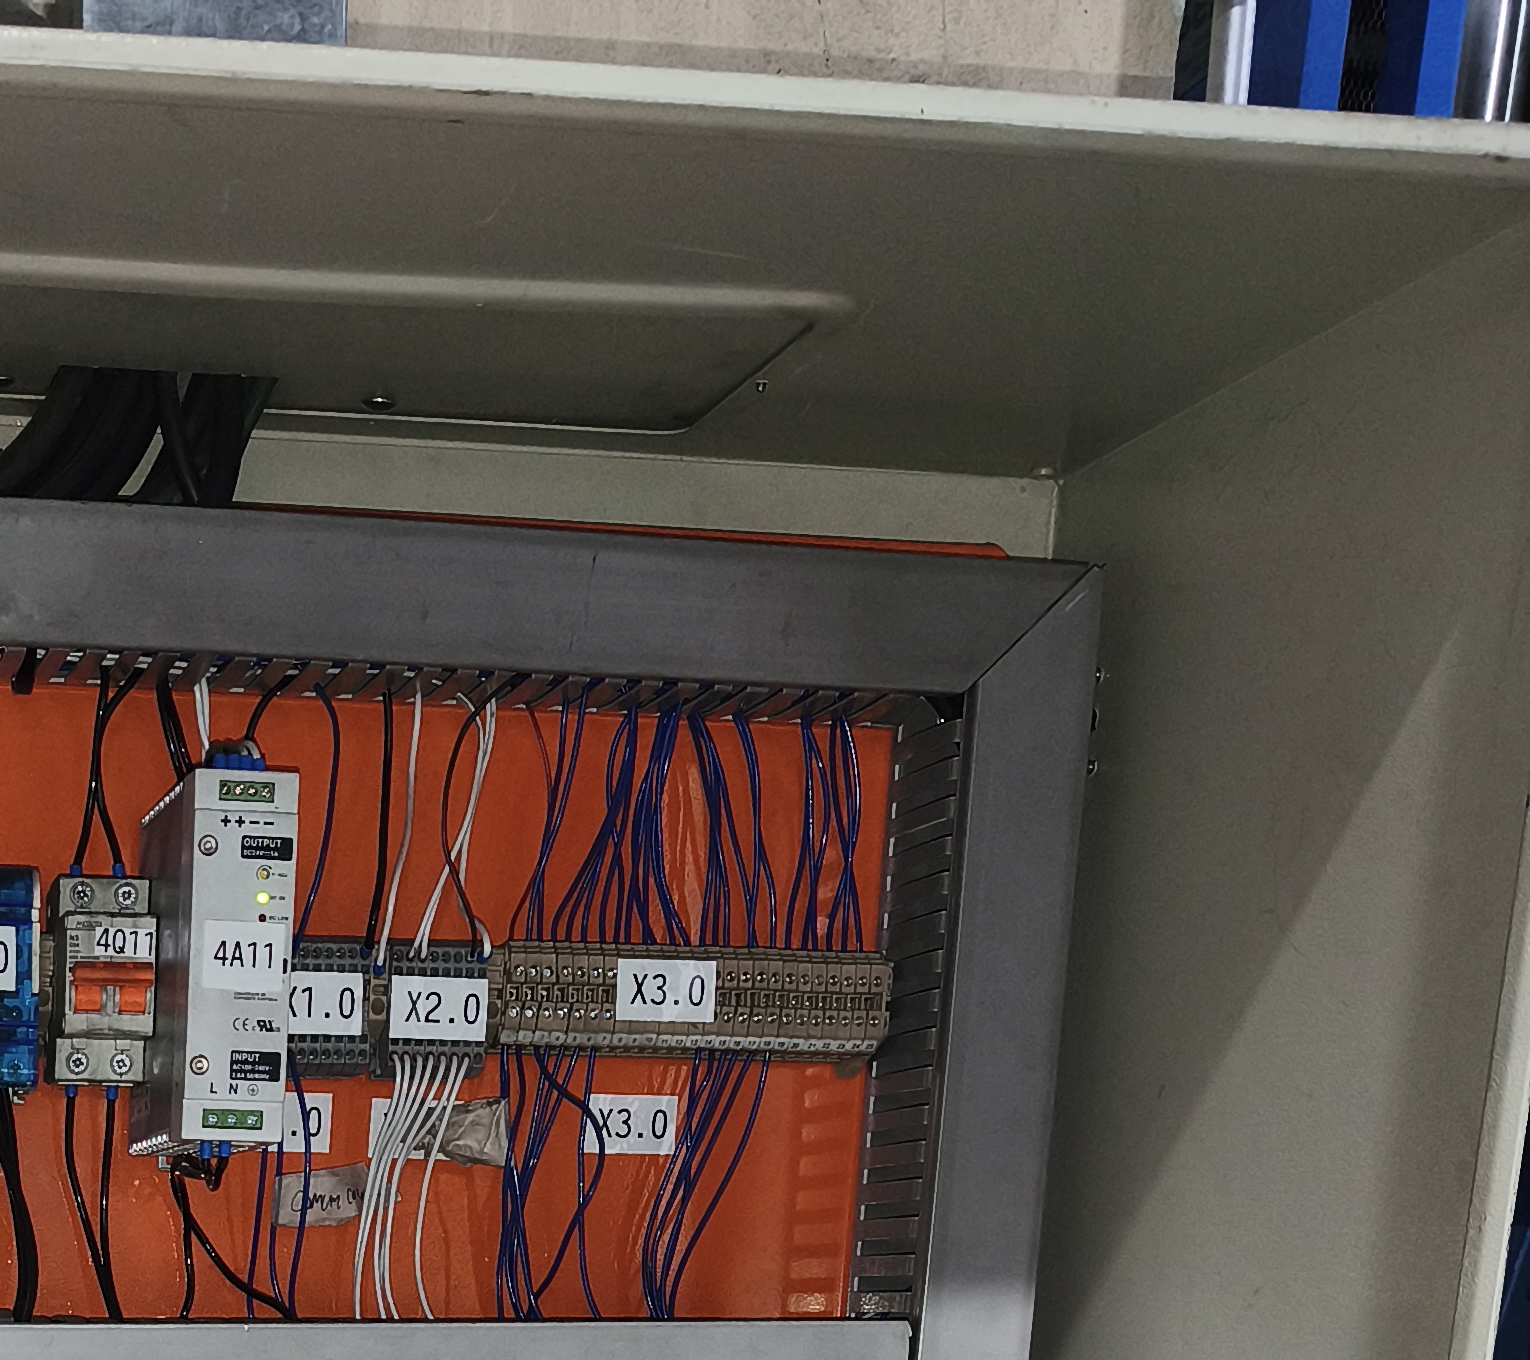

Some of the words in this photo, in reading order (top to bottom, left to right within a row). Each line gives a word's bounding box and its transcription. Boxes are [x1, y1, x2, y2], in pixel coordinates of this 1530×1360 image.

[243, 838, 282, 847] OUTPUT
[96, 927, 154, 957] 4Q11
[214, 941, 273, 969] 4A11
[630, 972, 706, 1007] X3.0
[405, 991, 481, 1025] X2.0
[232, 1052, 260, 1062] INPUT
[210, 1082, 218, 1094] L
[229, 1082, 238, 1095] N
[598, 1107, 668, 1140] X3.0
